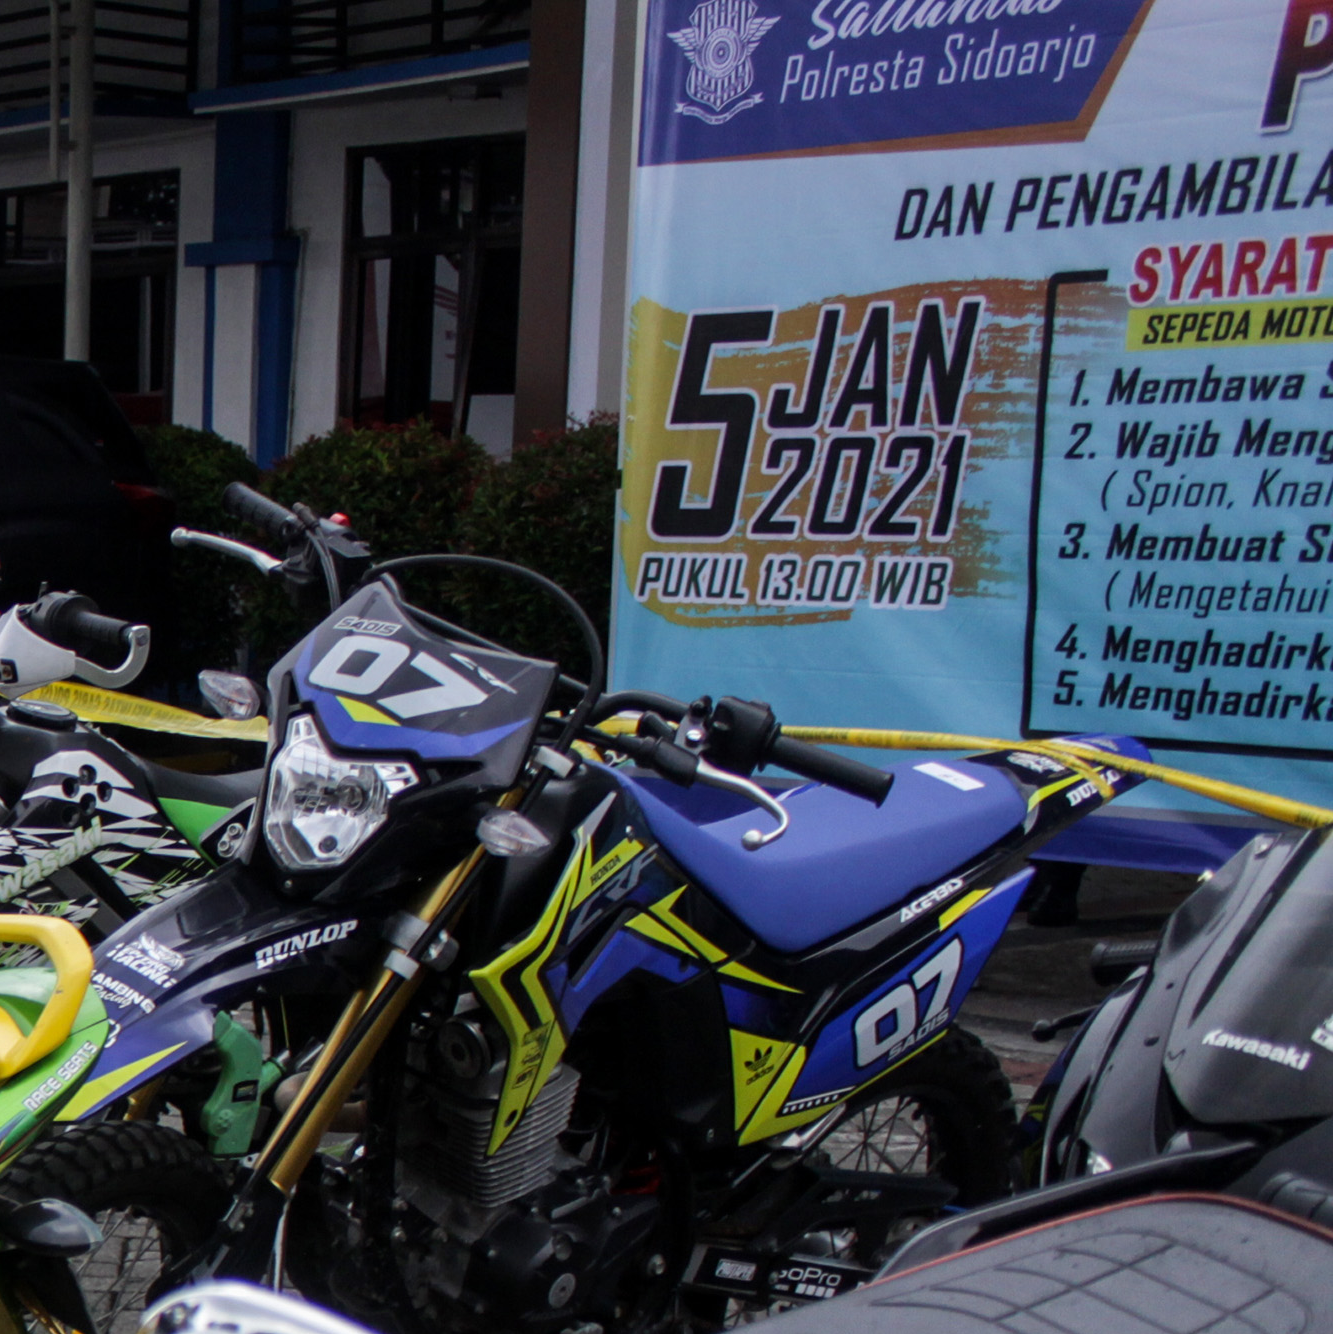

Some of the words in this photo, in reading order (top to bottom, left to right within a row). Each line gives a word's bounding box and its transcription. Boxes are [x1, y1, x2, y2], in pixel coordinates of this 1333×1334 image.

[780, 49, 926, 103] Polresta
[937, 25, 1097, 84] Sidoarjo
[894, 181, 994, 241] DAN
[1129, 236, 1333, 305] SYARAT
[1142, 310, 1250, 344] SEPEDA
[1069, 369, 1090, 407] 1.
[1105, 364, 1306, 406] Membawa
[650, 309, 775, 538] 5
[767, 300, 982, 429] JAN
[1064, 422, 1096, 460] 2.
[1116, 420, 1221, 467] Wajib
[751, 434, 968, 537] 2021
[1058, 523, 1090, 559] 3.
[1105, 523, 1286, 562] Membuat
[638, 557, 746, 599] PUKUL
[761, 558, 862, 602] 13.00
[873, 561, 948, 605] WIB
[336, 618, 399, 634] SADIS
[1054, 623, 1086, 659] 4.
[1102, 625, 1333, 674] Menghadirk
[309, 635, 489, 718] 07
[1053, 670, 1083, 707] 5.
[590, 855, 621, 886] HONDA
[255, 919, 358, 970] DUNLOP
[92, 970, 156, 1014] AMBING
[854, 936, 964, 1069] 07
[887, 1009, 949, 1060] SADIS
[1202, 1029, 1311, 1070] Kawasaki
[779, 1267, 841, 1286] oPro
